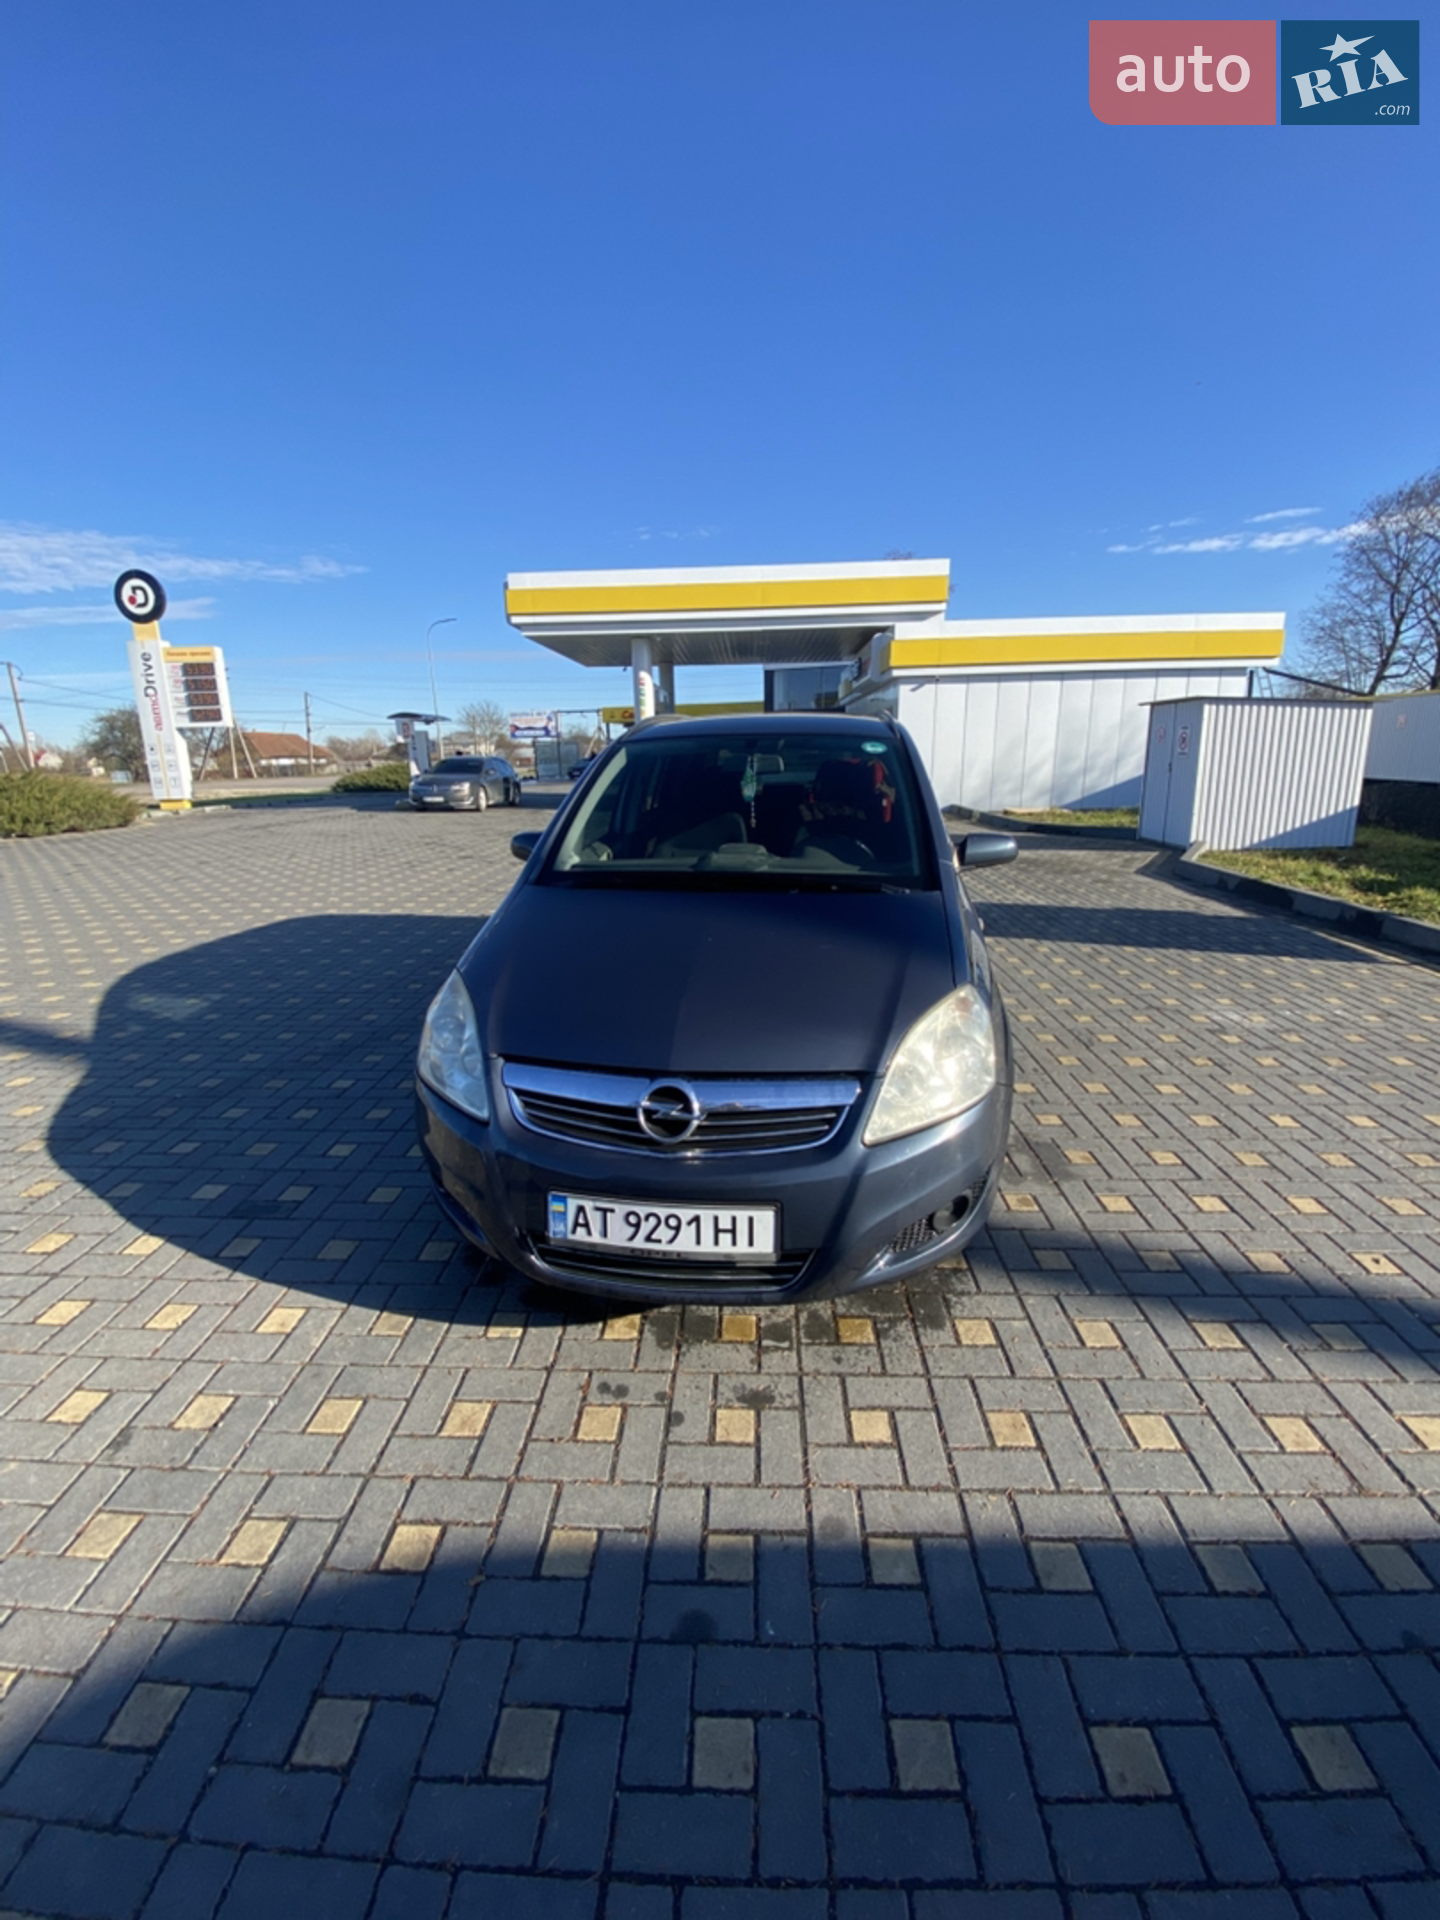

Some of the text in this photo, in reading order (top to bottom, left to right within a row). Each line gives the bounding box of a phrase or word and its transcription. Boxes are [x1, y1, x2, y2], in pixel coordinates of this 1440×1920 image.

[571, 1205, 755, 1247] AT 9291 HI
